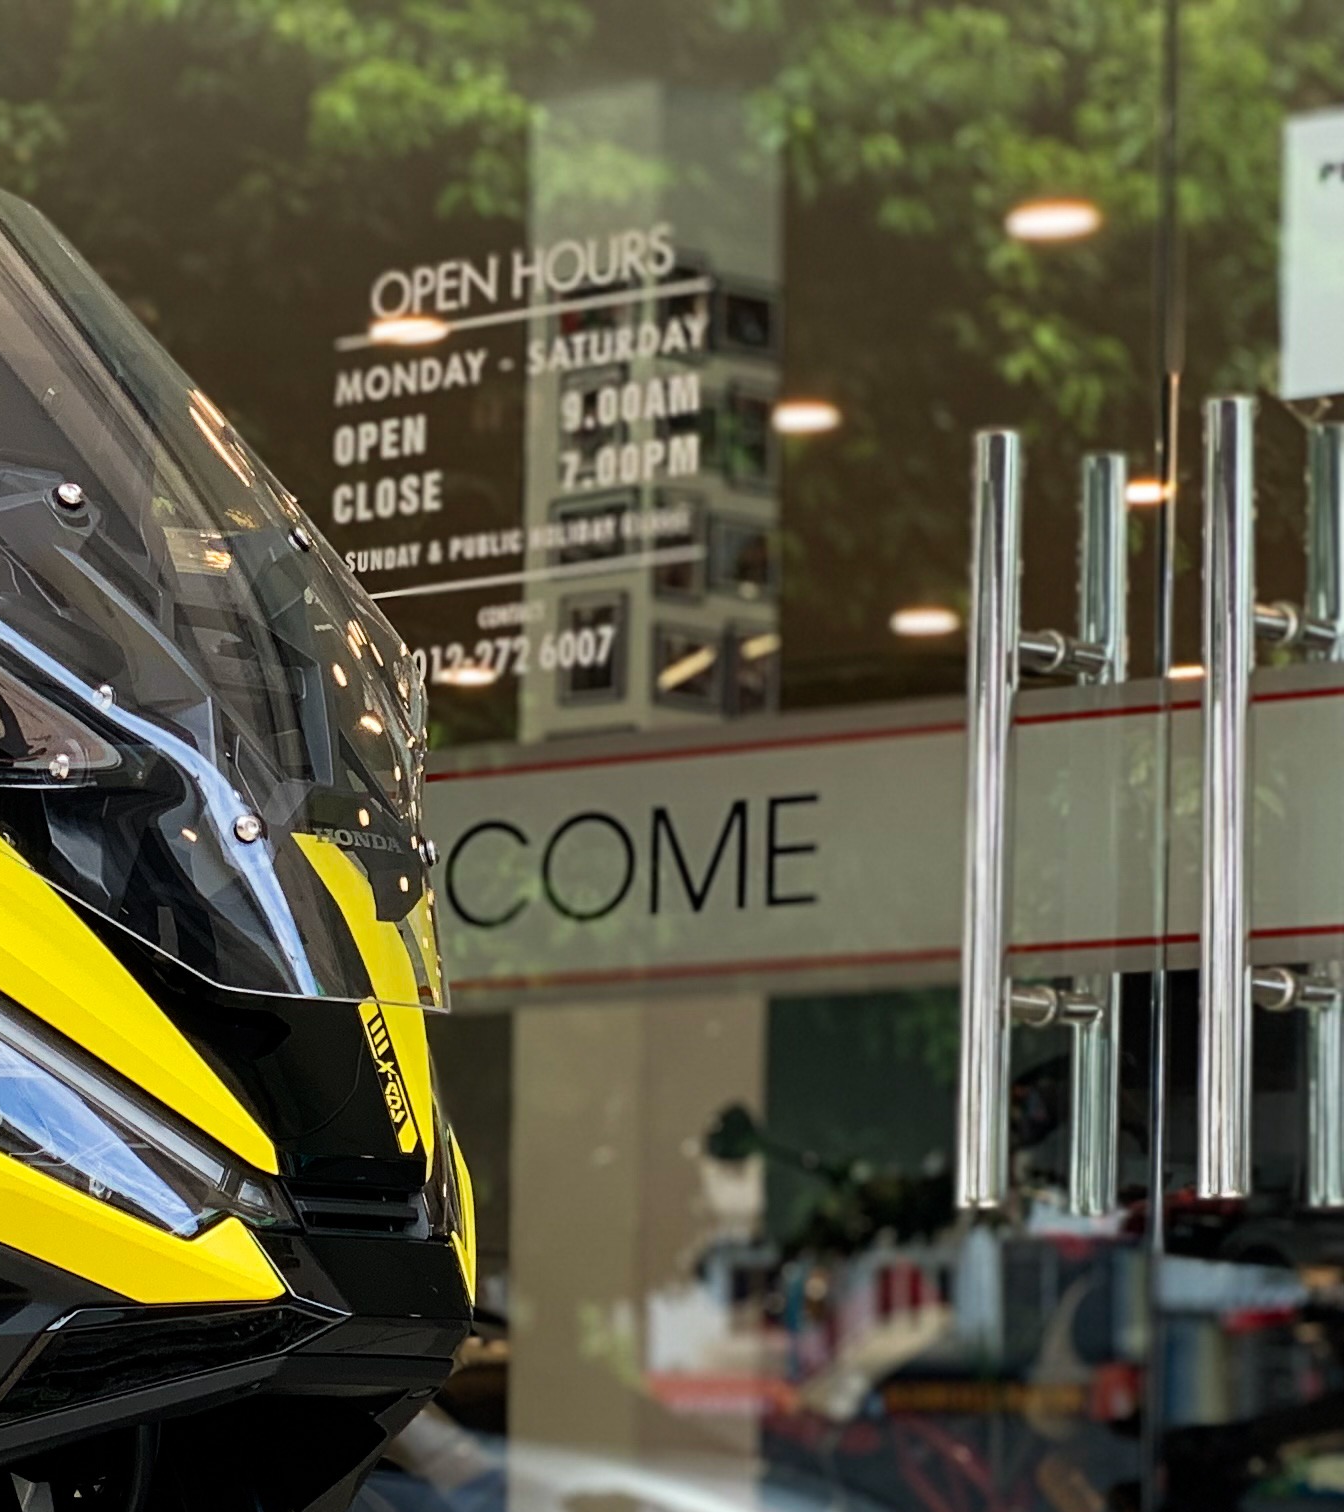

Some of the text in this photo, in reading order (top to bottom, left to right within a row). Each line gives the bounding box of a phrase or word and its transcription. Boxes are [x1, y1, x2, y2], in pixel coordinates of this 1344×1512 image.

[371, 222, 675, 318] OPEN HOURS
[335, 349, 488, 407] MONDAY
[527, 313, 709, 377] SATURDAY
[333, 373, 700, 466] OPEN 9.00AM
[332, 434, 700, 524] CLOSE 7.00PM
[345, 544, 421, 574] SUNDAY
[427, 540, 443, 564] &
[449, 529, 522, 562] PUBLIC
[539, 625, 616, 671] 6007
[313, 827, 405, 855] HONDA
[376, 1059, 406, 1124] X-ADV
